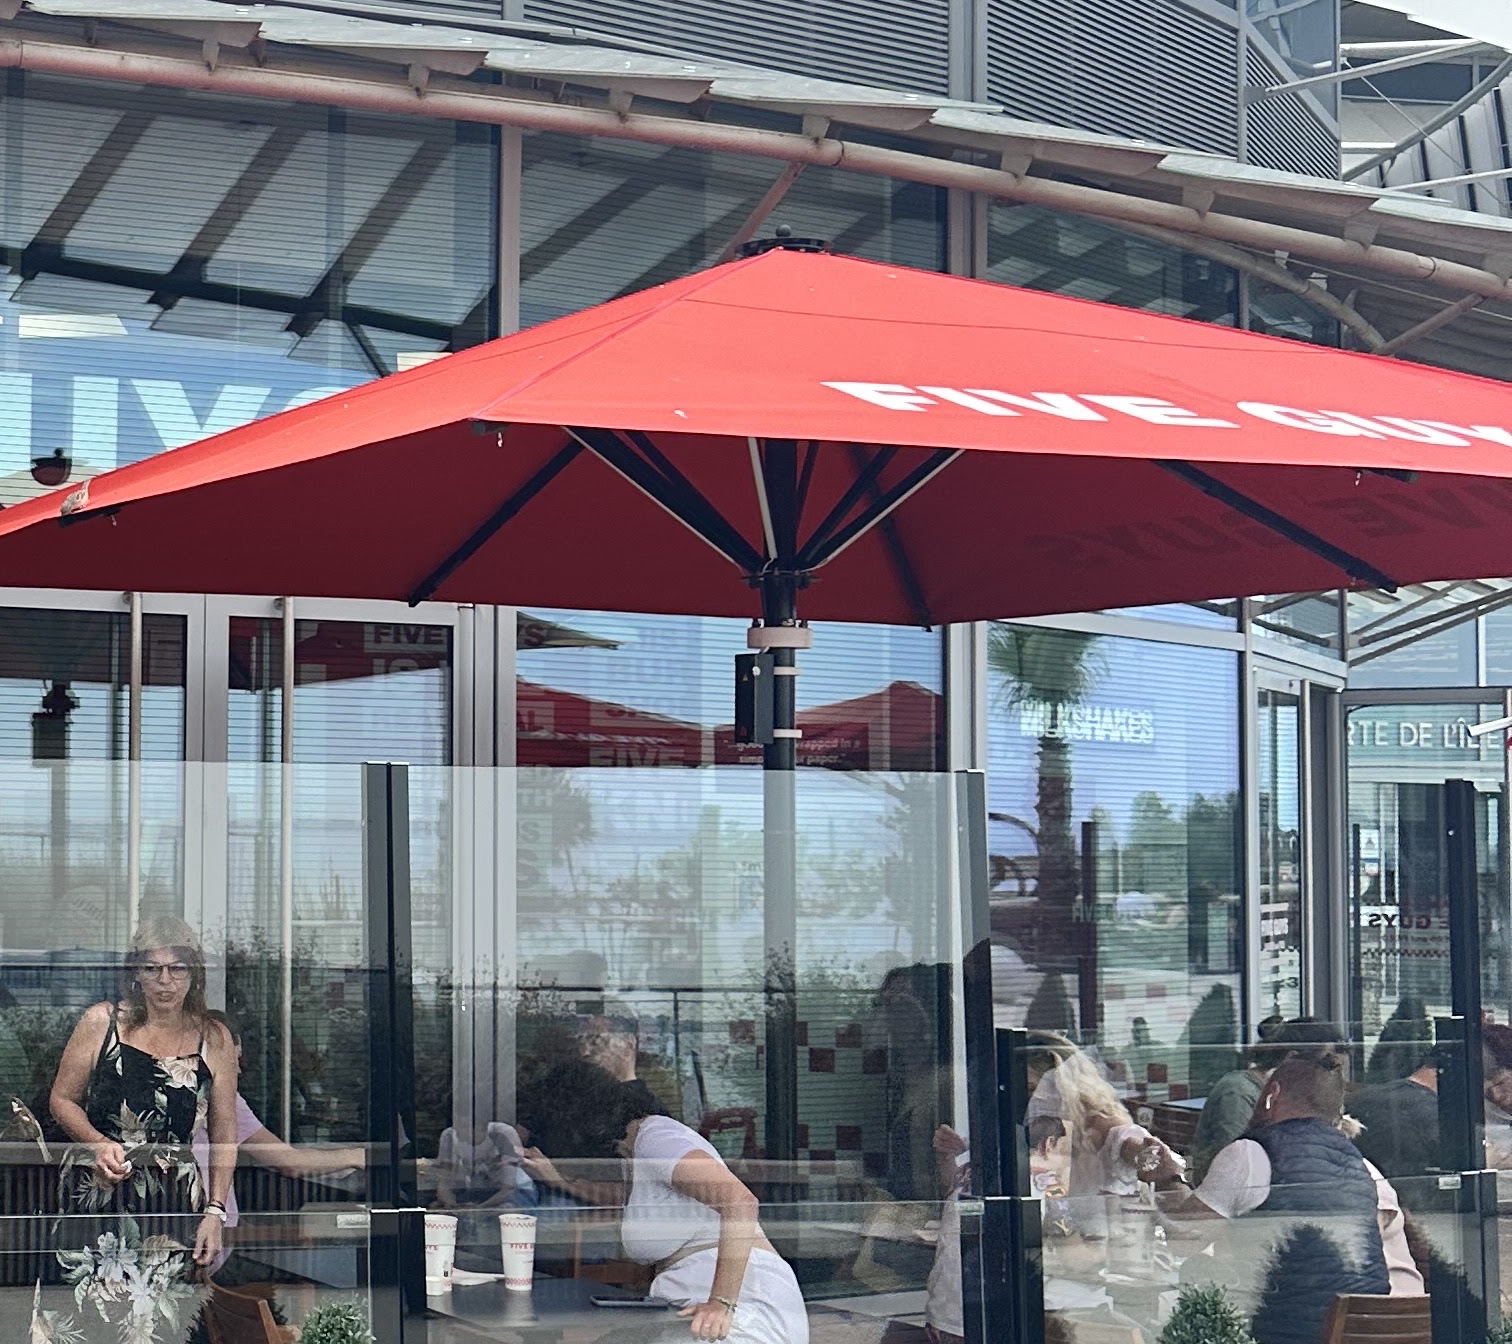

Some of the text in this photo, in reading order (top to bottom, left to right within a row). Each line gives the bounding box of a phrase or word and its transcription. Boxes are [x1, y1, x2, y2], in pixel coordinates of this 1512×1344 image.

[819, 381, 1241, 429] FIVE
[374, 624, 445, 645] FIVE
[1399, 722, 1432, 748] DE
